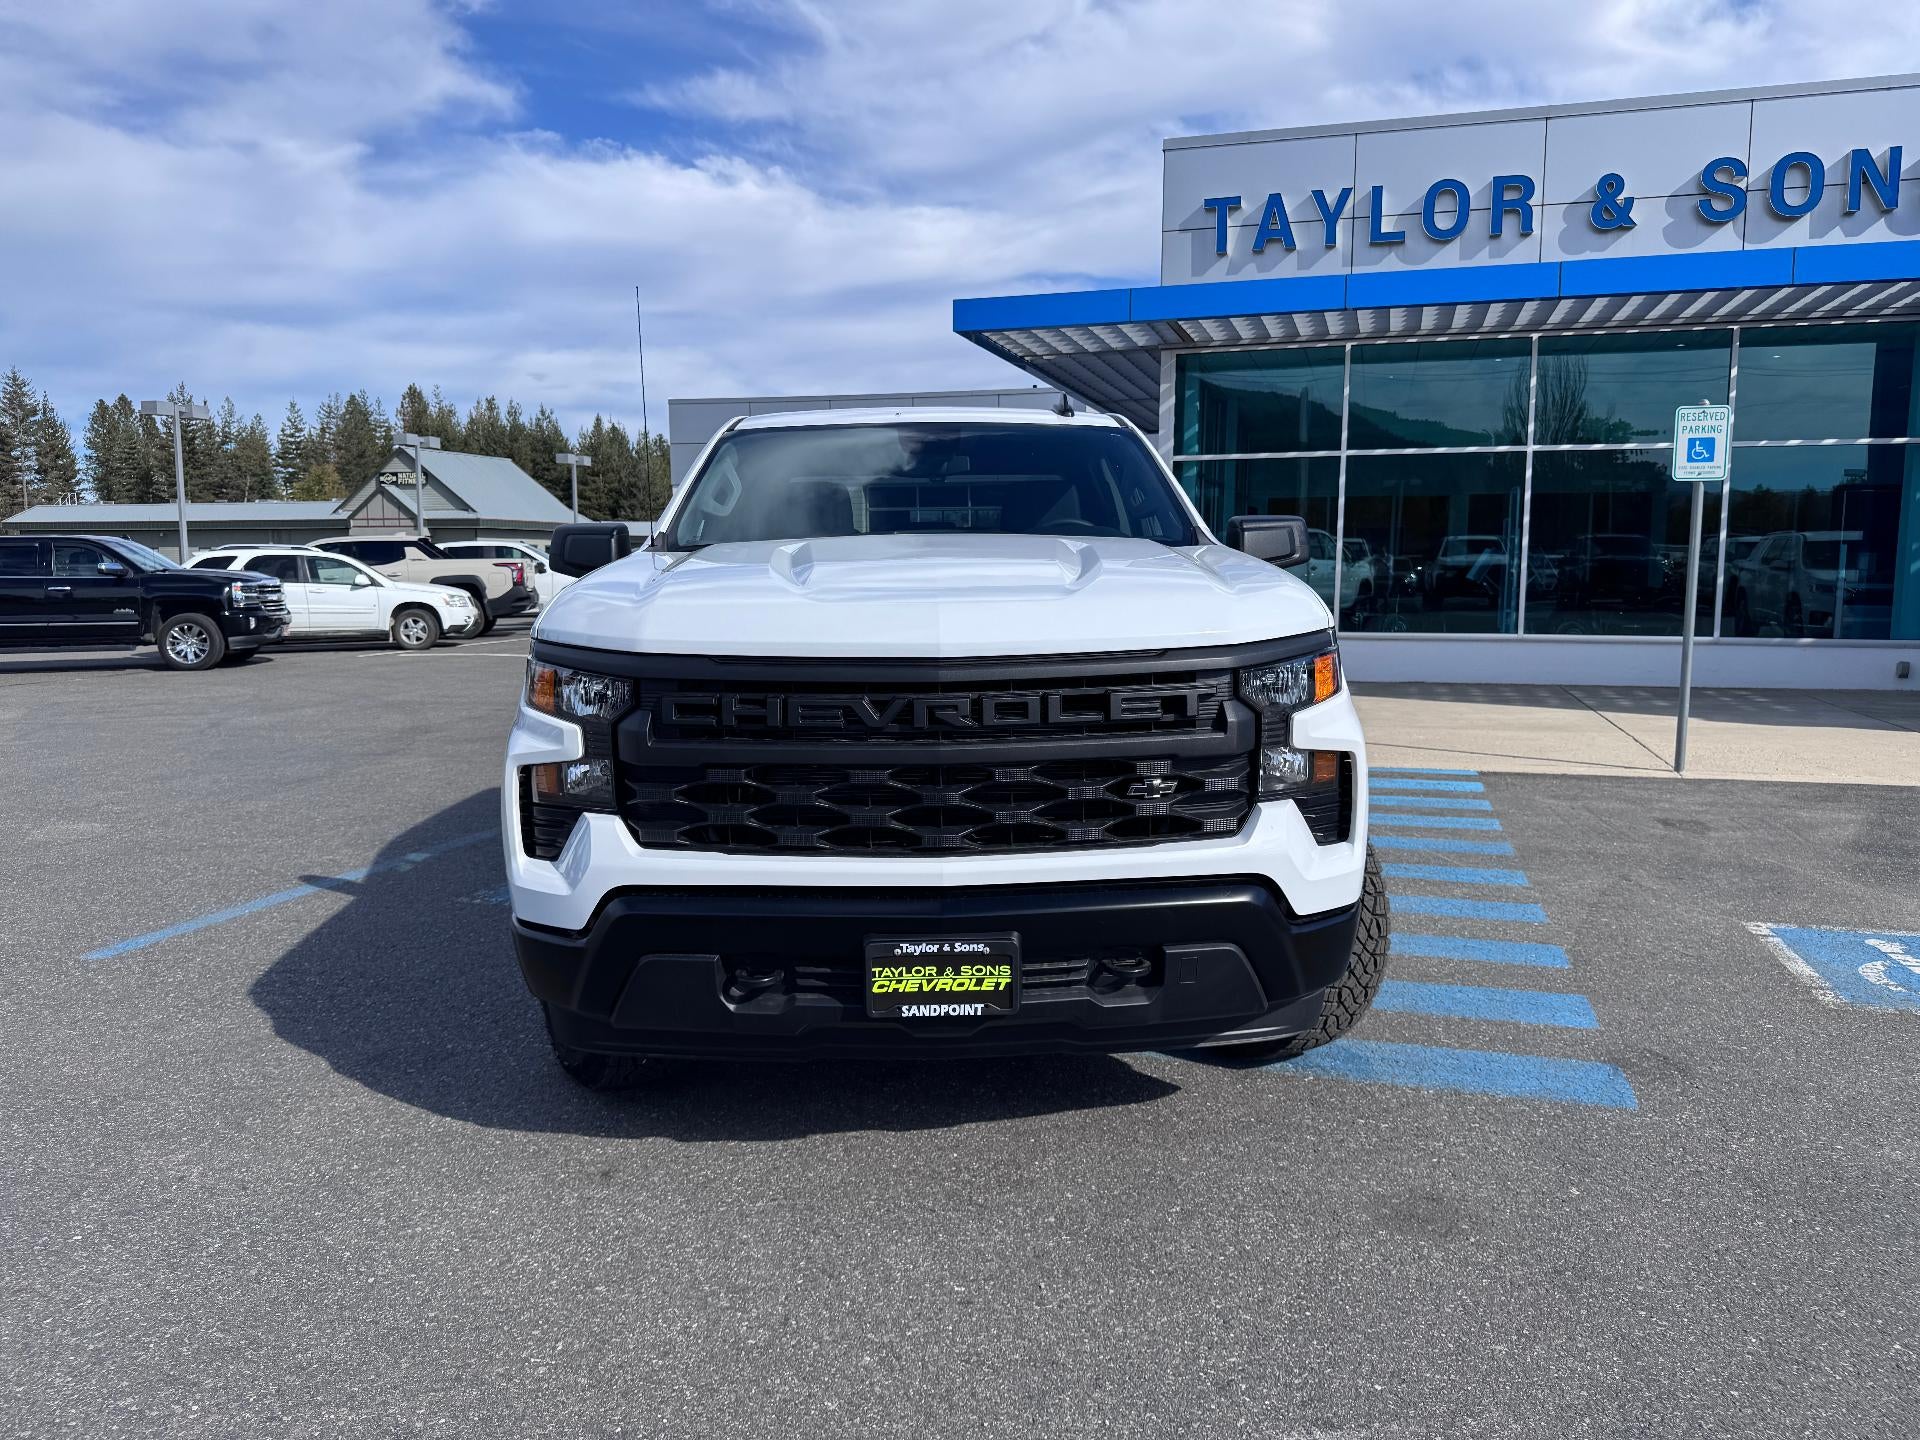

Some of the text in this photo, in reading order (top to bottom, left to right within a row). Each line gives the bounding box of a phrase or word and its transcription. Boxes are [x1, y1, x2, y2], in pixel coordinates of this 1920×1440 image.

[1203, 174, 1537, 256] TAYLOR
[1588, 172, 1638, 237] &
[1680, 412, 1726, 421] RESERVED
[1682, 425, 1722, 434] PARKING
[661, 686, 1214, 729] CHEVROLET
[900, 942, 985, 956] Taylor & Sons
[872, 965, 1012, 978] TAYLOR & SONS
[872, 978, 1012, 993] CHEVROLET
[901, 1003, 985, 1017] SANDPOINT
